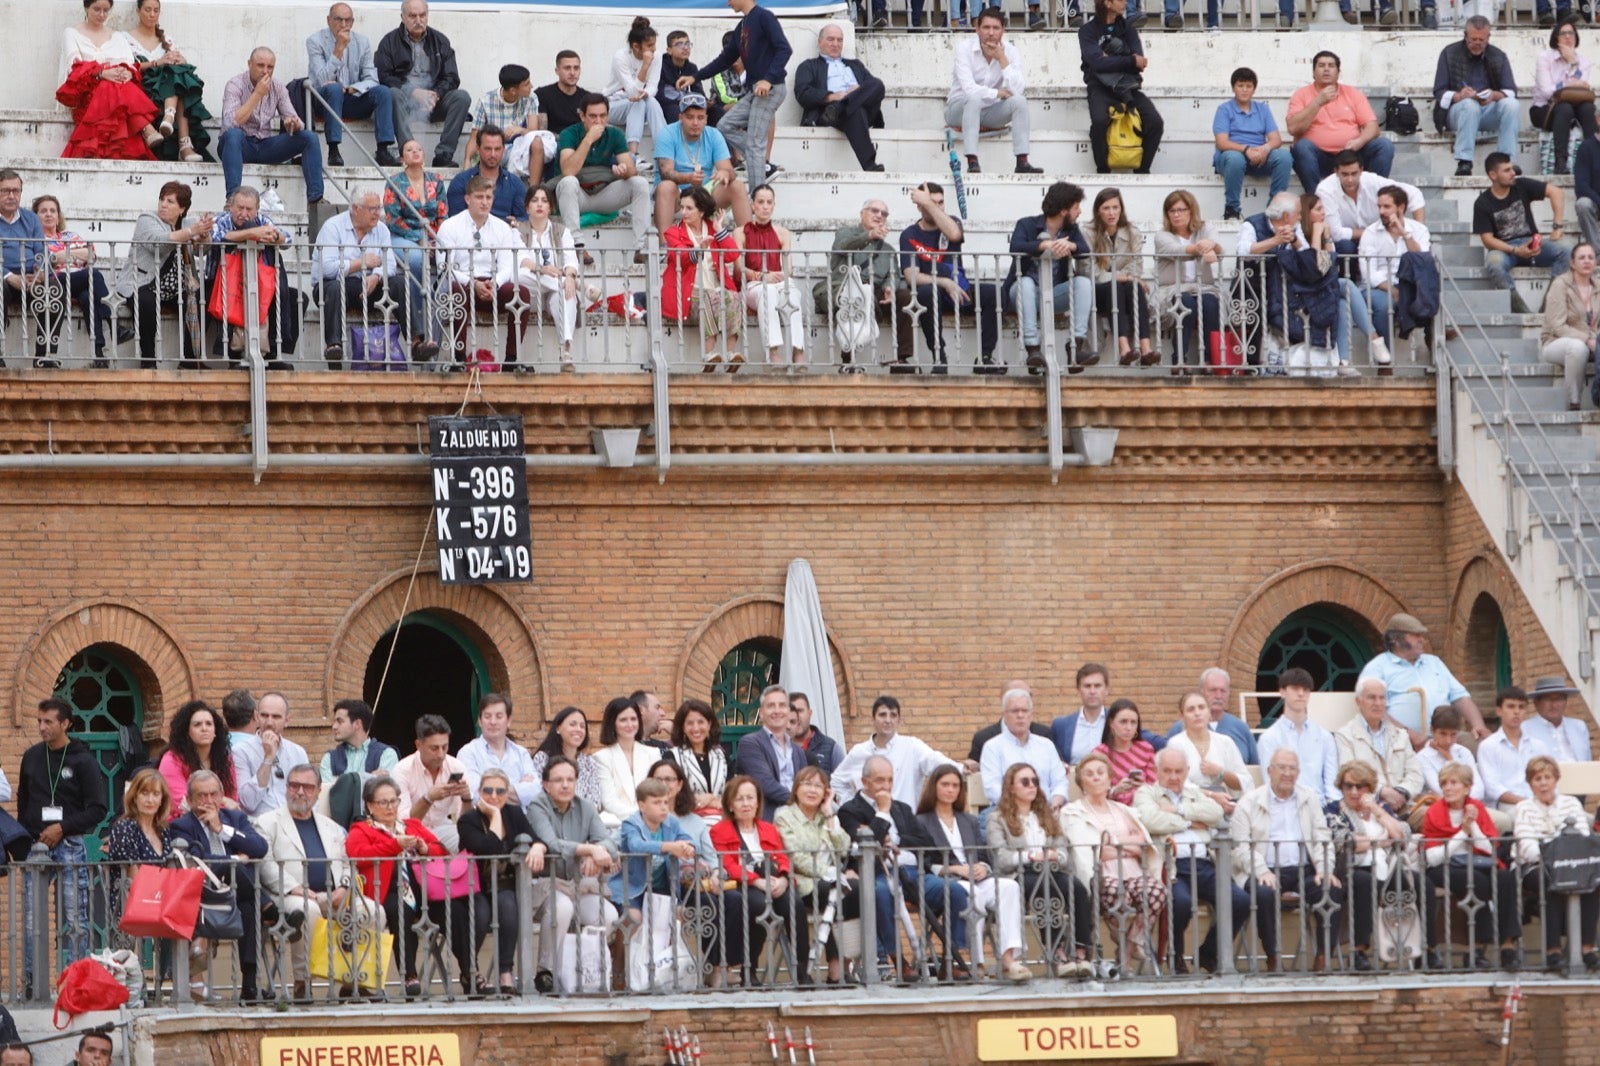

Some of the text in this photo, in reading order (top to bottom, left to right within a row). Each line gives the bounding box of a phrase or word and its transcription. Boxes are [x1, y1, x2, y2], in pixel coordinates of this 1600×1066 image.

[56, 173, 69, 183] 41
[966, 187, 979, 197] 10
[439, 429, 518, 449] ZALDUENDO
[436, 505, 517, 541] K -576
[466, 545, 530, 580] 04-19
[1017, 1025, 1141, 1051] TORILES
[279, 1044, 444, 1066] ENFERMERIA
